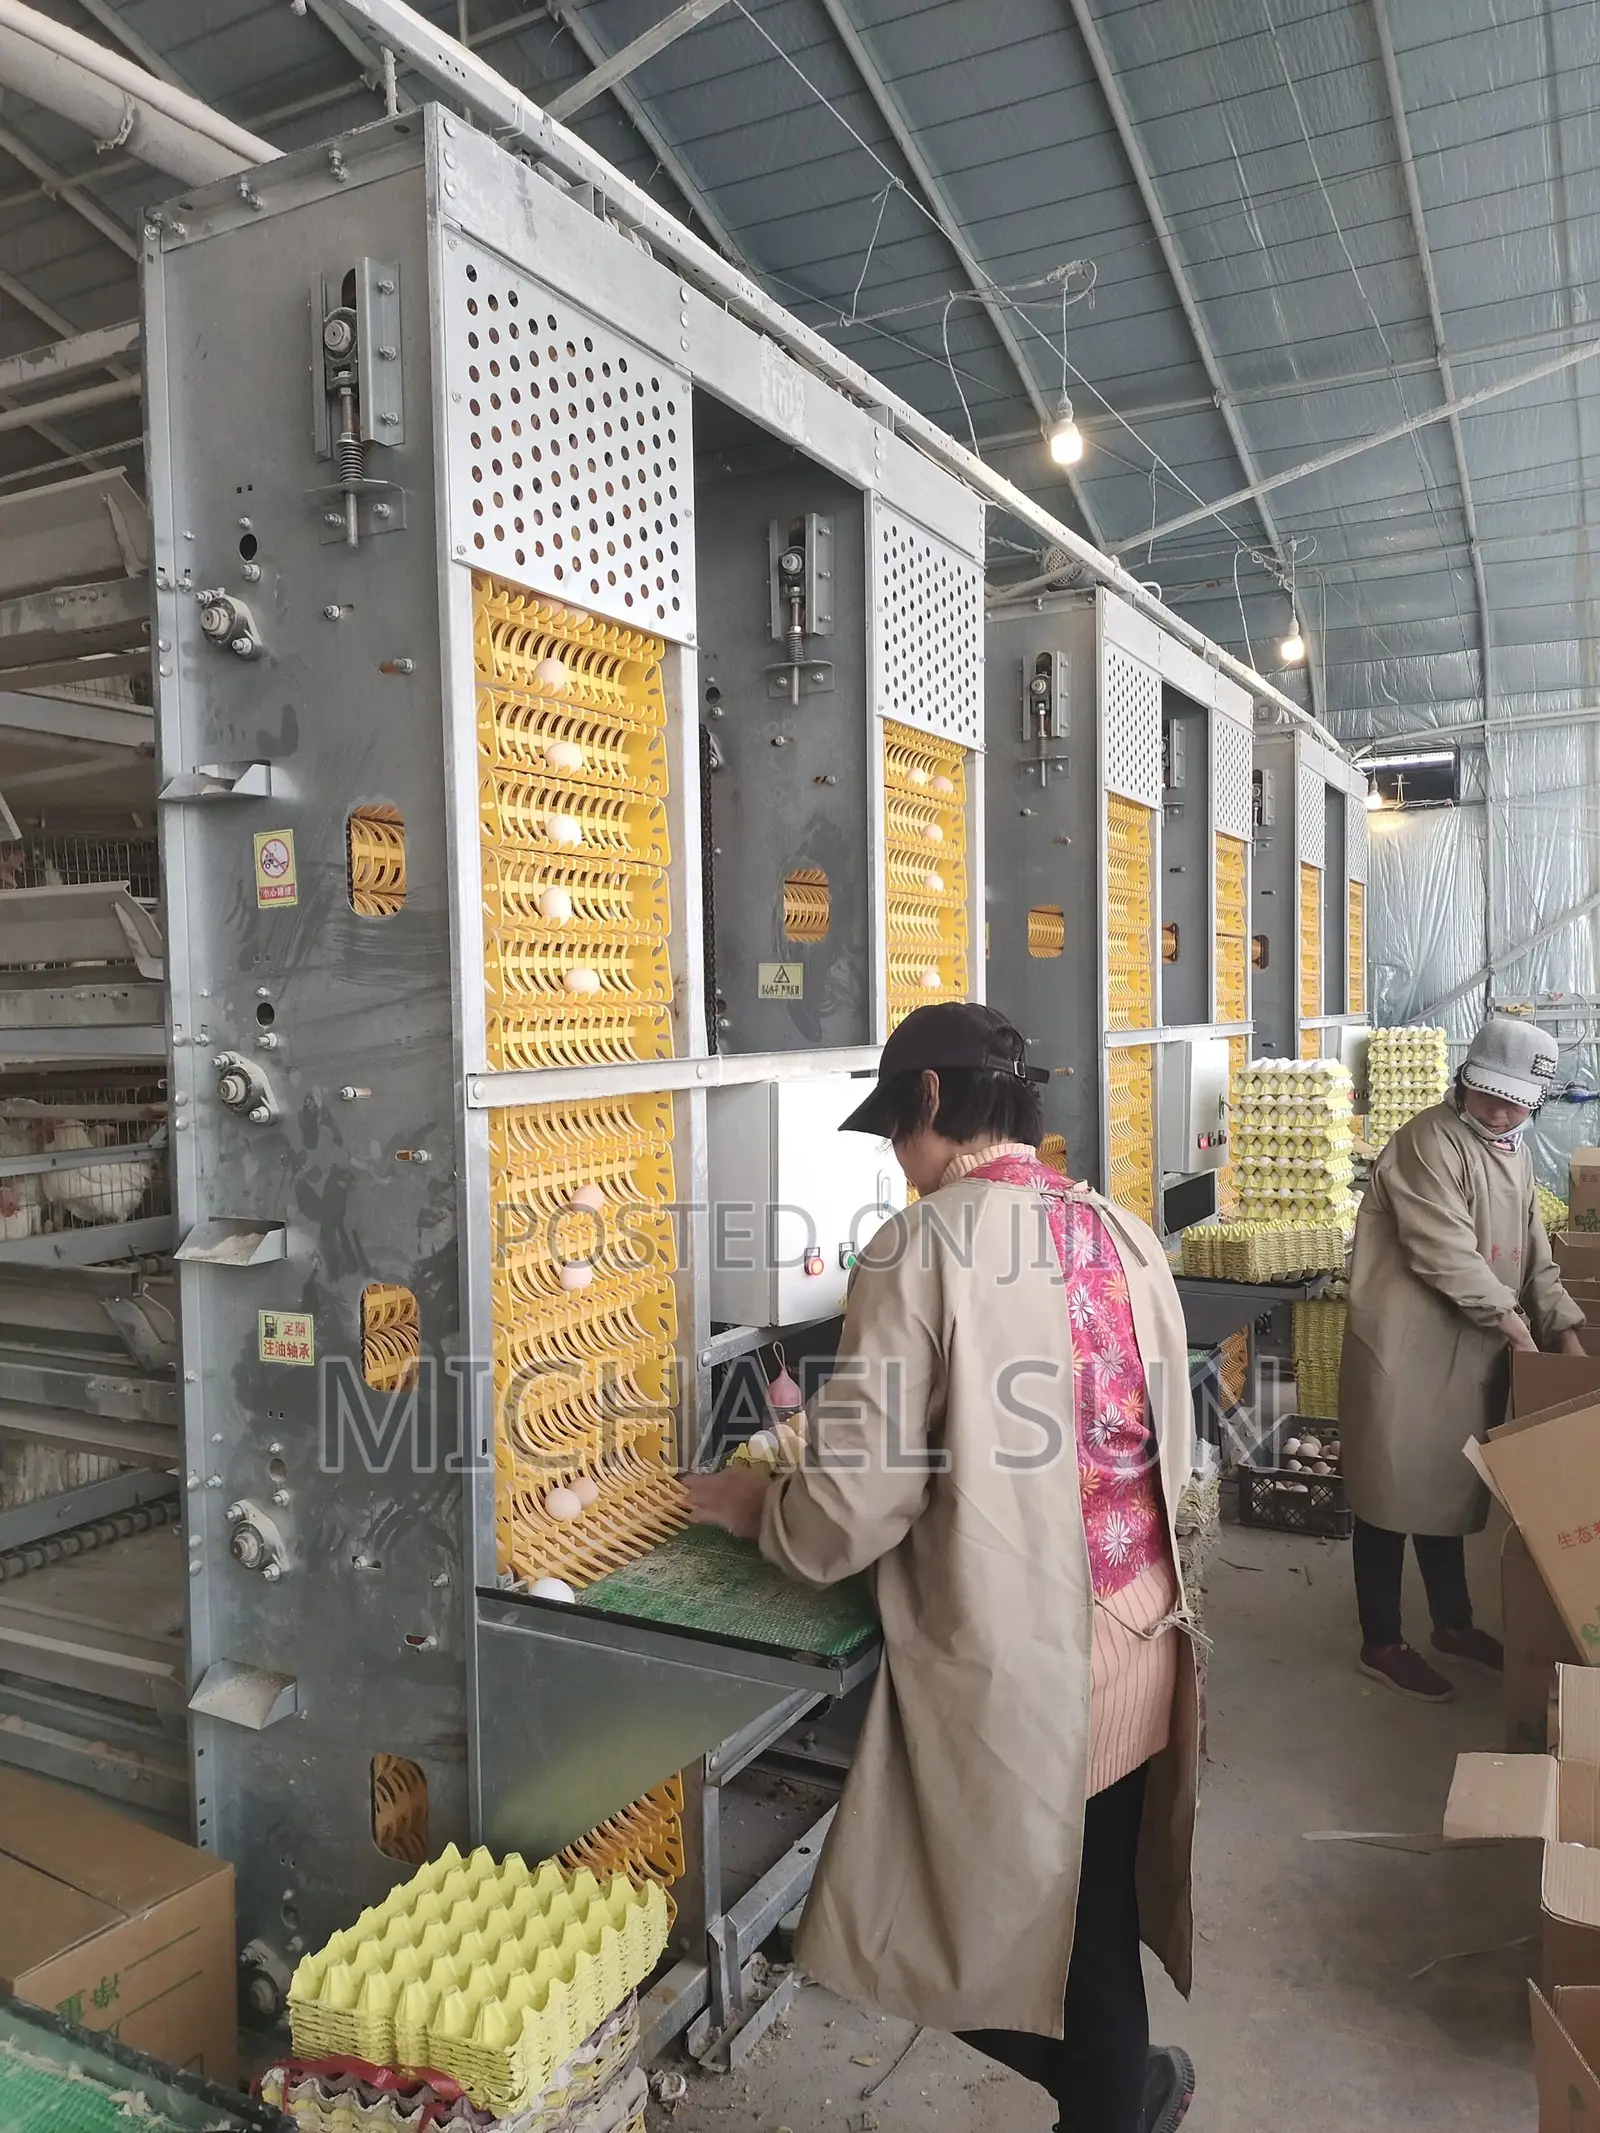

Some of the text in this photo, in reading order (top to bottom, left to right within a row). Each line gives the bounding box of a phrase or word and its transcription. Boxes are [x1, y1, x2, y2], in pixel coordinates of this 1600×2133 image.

[282, 1320, 306, 1338] 定期
[263, 1340, 310, 1359] 注油轴承
